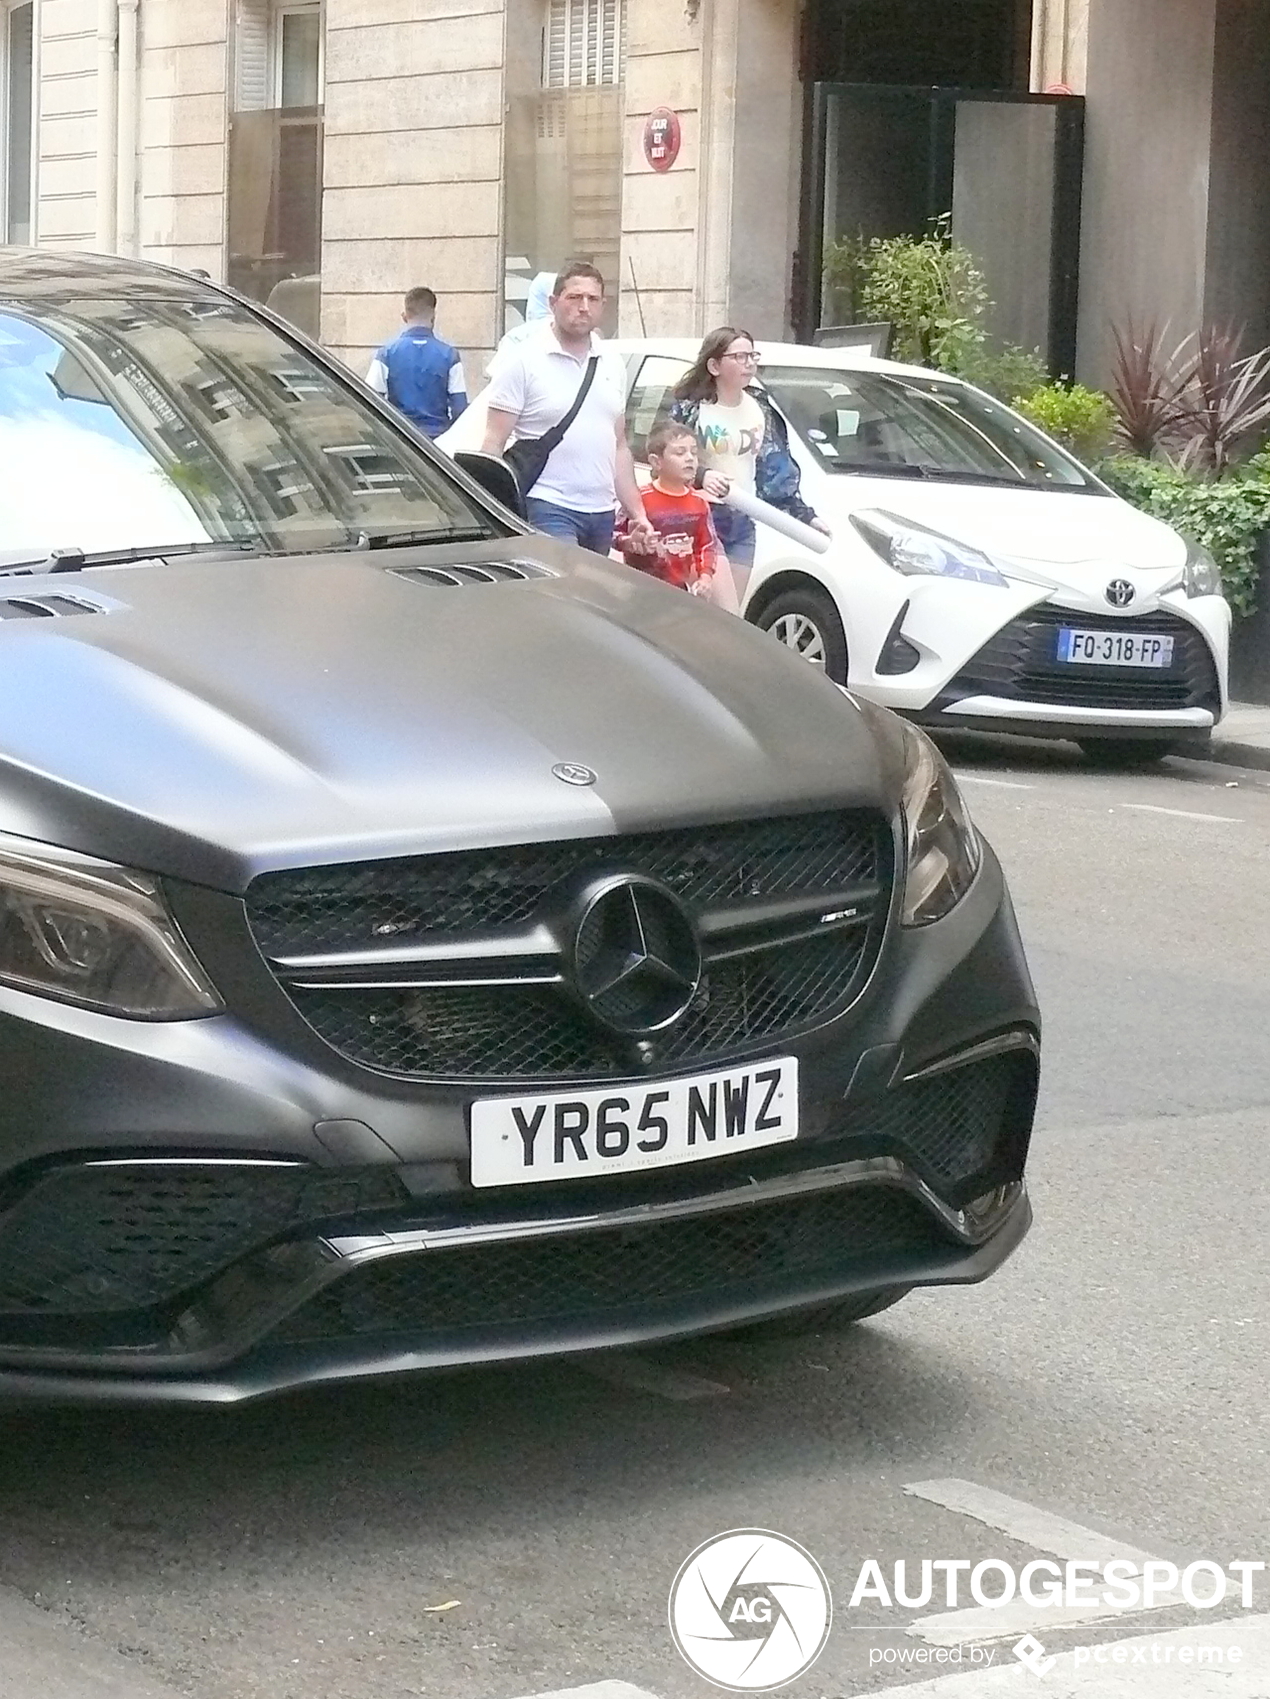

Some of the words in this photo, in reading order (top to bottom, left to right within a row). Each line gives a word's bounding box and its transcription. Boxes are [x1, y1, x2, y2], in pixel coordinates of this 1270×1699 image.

[653, 132, 663, 144] ET
[1072, 634, 1161, 662] FQ-318-FP
[511, 1091, 670, 1167] YR65
[687, 1067, 782, 1146] NWZ
